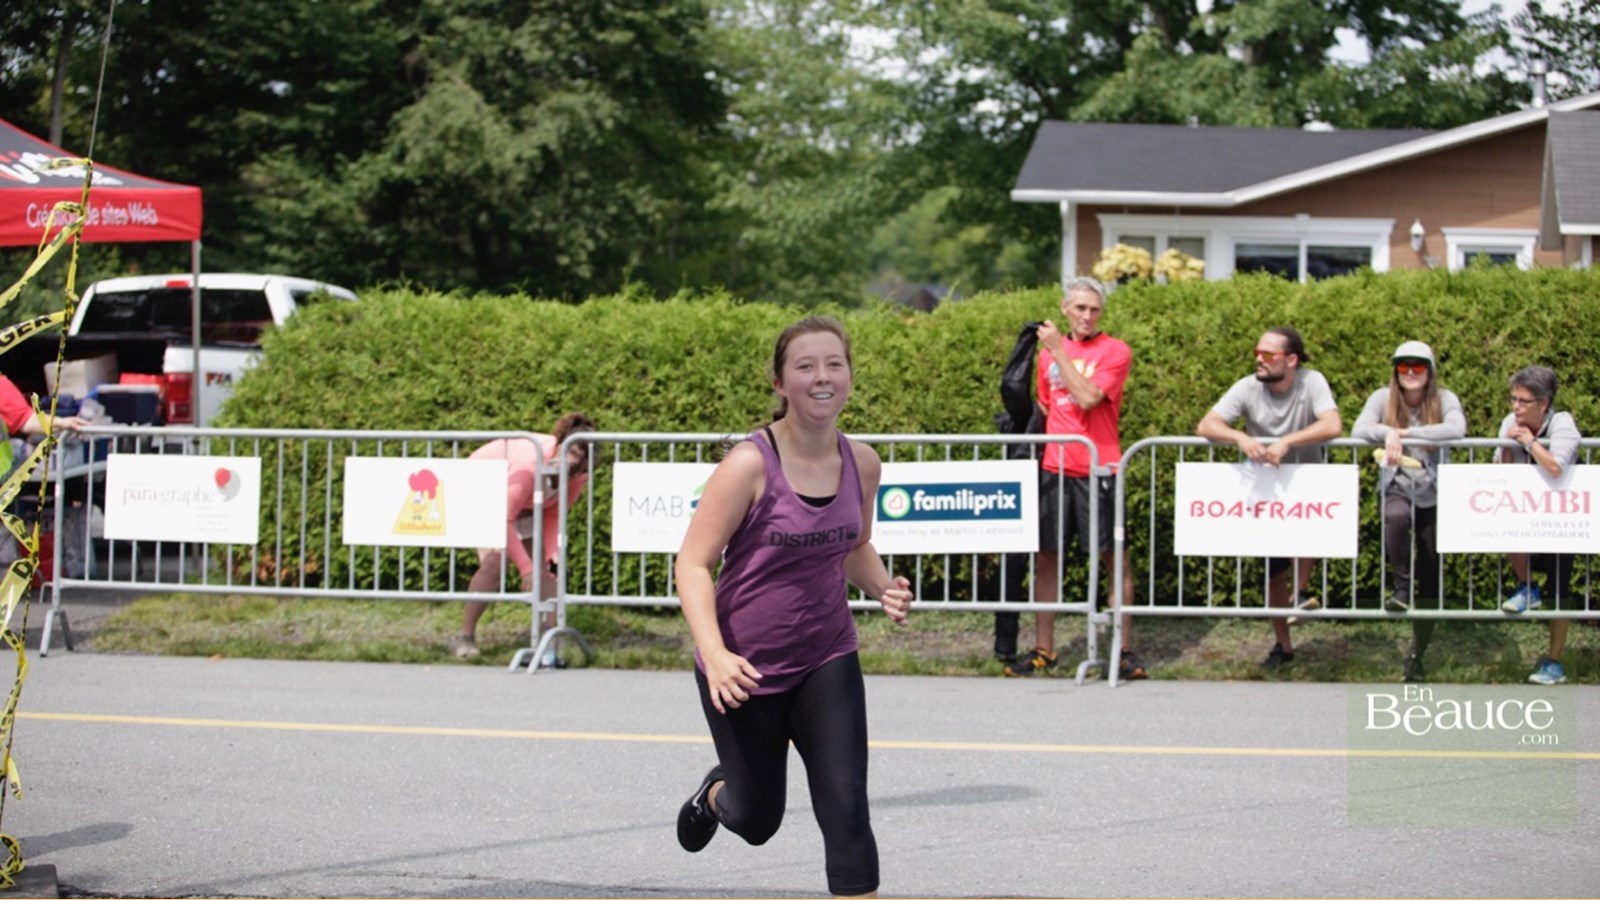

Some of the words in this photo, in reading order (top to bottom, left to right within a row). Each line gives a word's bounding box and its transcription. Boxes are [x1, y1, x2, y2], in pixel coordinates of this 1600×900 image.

[101, 202, 128, 225] sites
[128, 202, 158, 225] Web
[628, 495, 684, 518] MAB
[912, 488, 1017, 516] familiprix
[1468, 489, 1591, 516] CAMBI
[769, 525, 848, 548] DISTRICT
